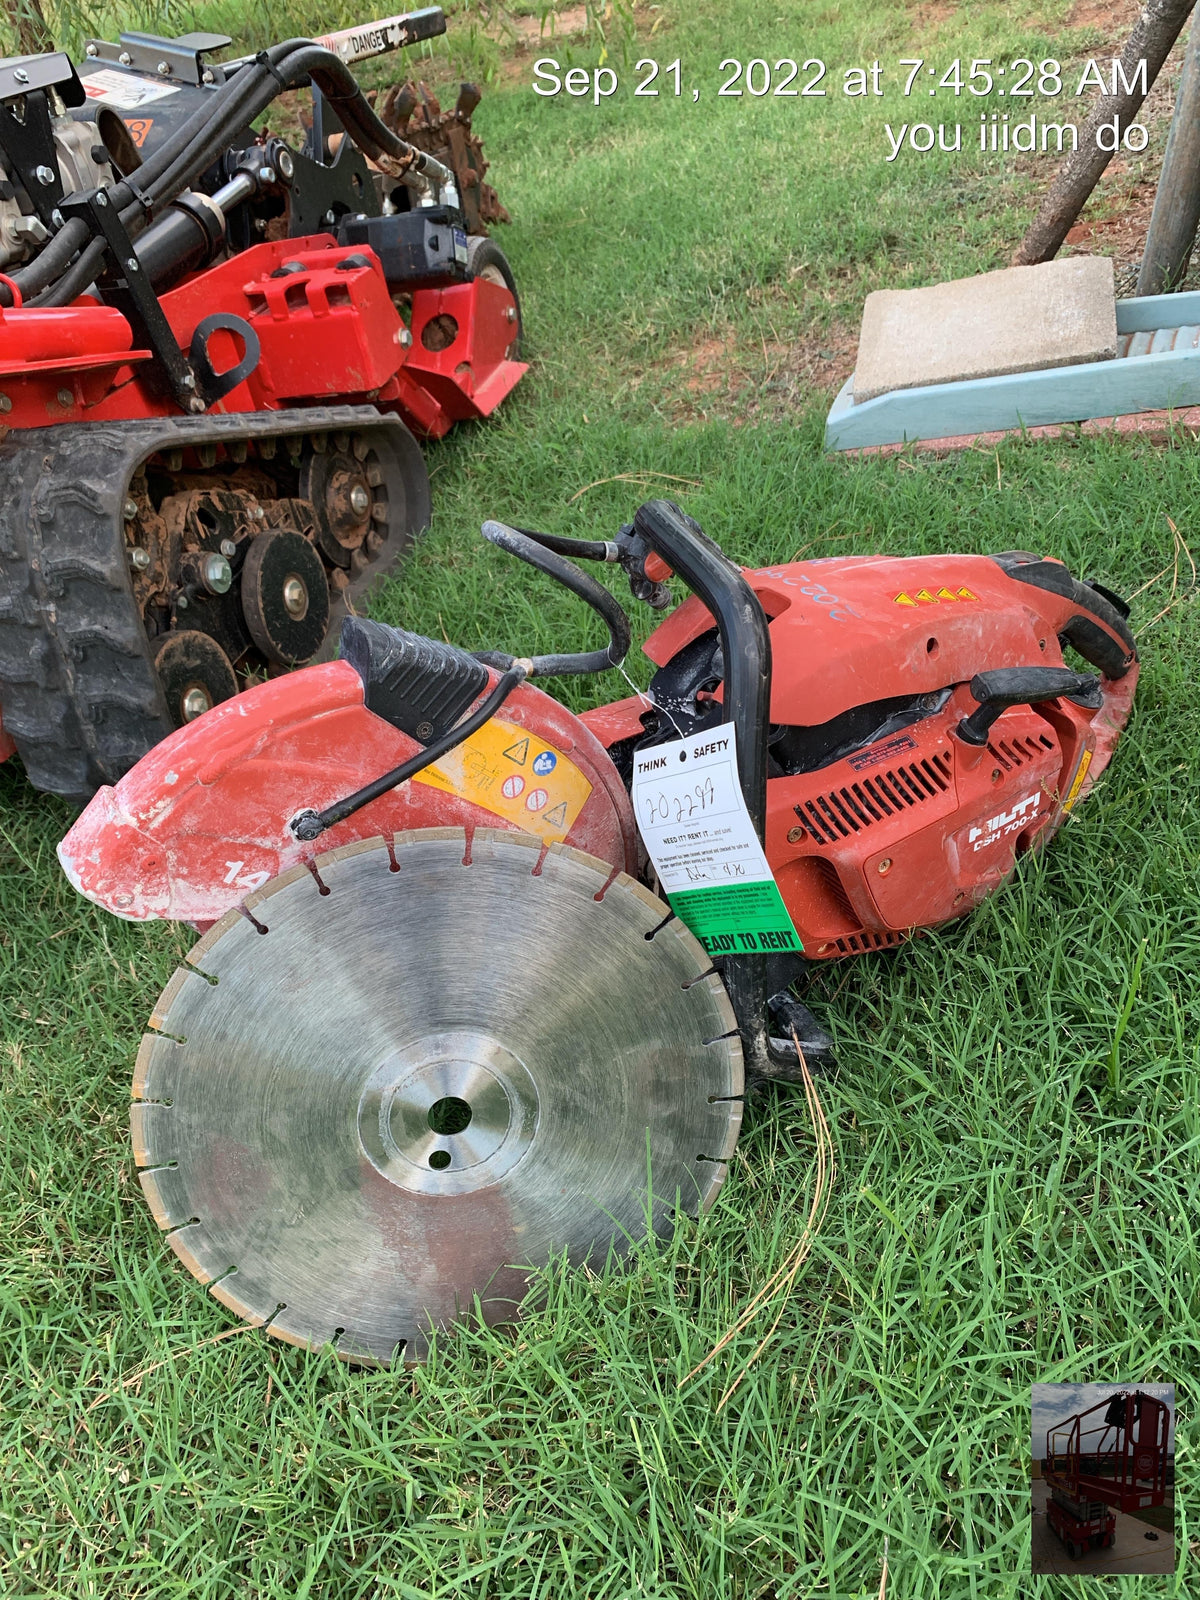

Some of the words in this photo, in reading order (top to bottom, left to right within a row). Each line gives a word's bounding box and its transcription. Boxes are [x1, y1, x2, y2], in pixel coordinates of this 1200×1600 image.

[351, 28, 388, 54] DANGE
[638, 757, 667, 773] THINK
[693, 739, 729, 759] SAFETY
[645, 777, 714, 824] 202299
[968, 791, 1041, 843] HILTI
[1004, 808, 1039, 836] 700-X
[662, 836, 678, 845] NEED
[678, 834, 687, 842] IT?
[687, 831, 702, 840] RENT
[702, 830, 709, 838] IT
[223, 860, 271, 893] 14
[701, 933, 738, 952] EADY
[736, 931, 758, 950] TO
[757, 930, 796, 950] RENT
